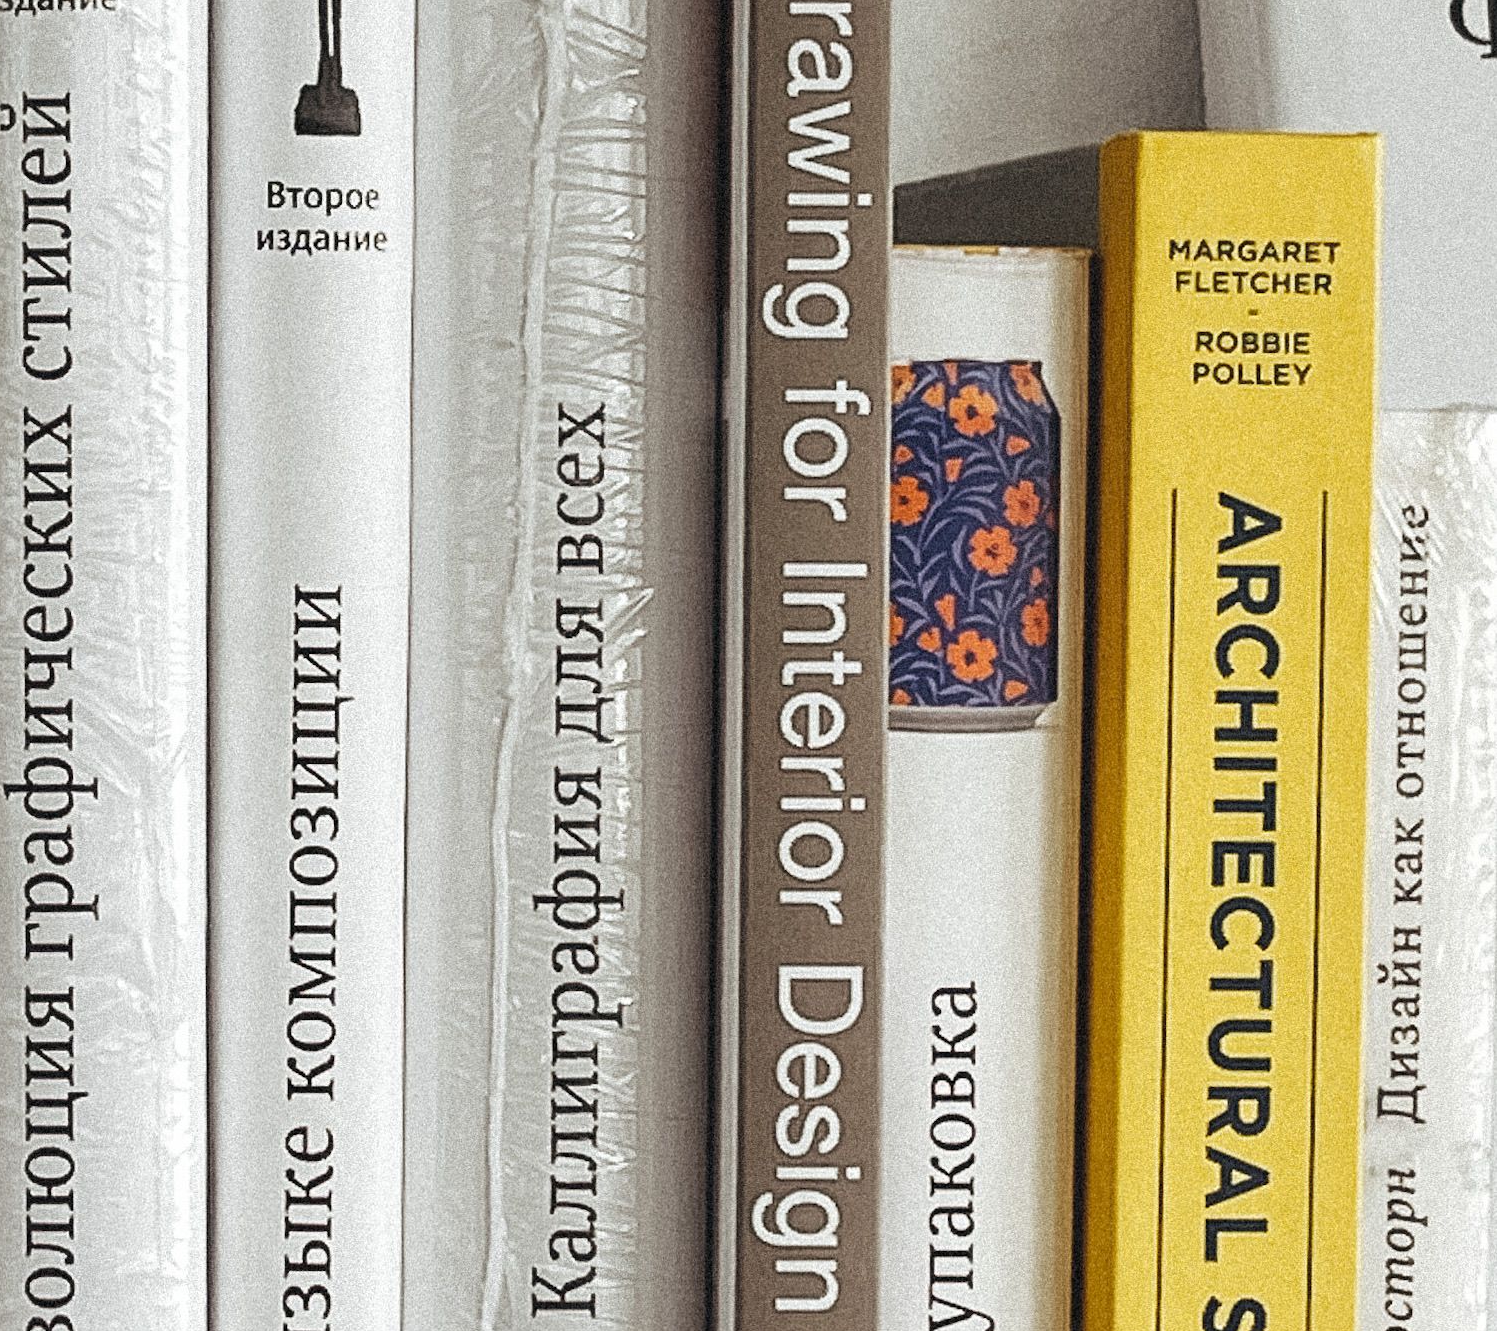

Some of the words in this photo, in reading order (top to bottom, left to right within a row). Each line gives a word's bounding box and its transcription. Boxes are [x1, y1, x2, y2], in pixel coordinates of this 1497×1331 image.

[0, 91, 73, 381] стилей
[256, 227, 389, 255] издание
[265, 180, 381, 215] Второе
[1169, 239, 1341, 264] MARGARET
[1175, 270, 1333, 295] FLETCHER
[1192, 363, 1313, 386] POLLEY
[1195, 331, 1311, 355] ROBBIE
[556, 402, 606, 575] всех
[783, 379, 872, 523] for
[3, 406, 99, 961] графических
[554, 598, 614, 743] для
[1396, 504, 1430, 799] отношение
[777, 562, 868, 925] Interior
[286, 583, 355, 1102] композиции
[1204, 491, 1283, 1263] ARCHITECTURAL
[1393, 817, 1425, 905] как
[531, 766, 625, 1318] Каллиграфия
[1376, 925, 1426, 1124] Дизайн
[752, 964, 864, 1312] Design
